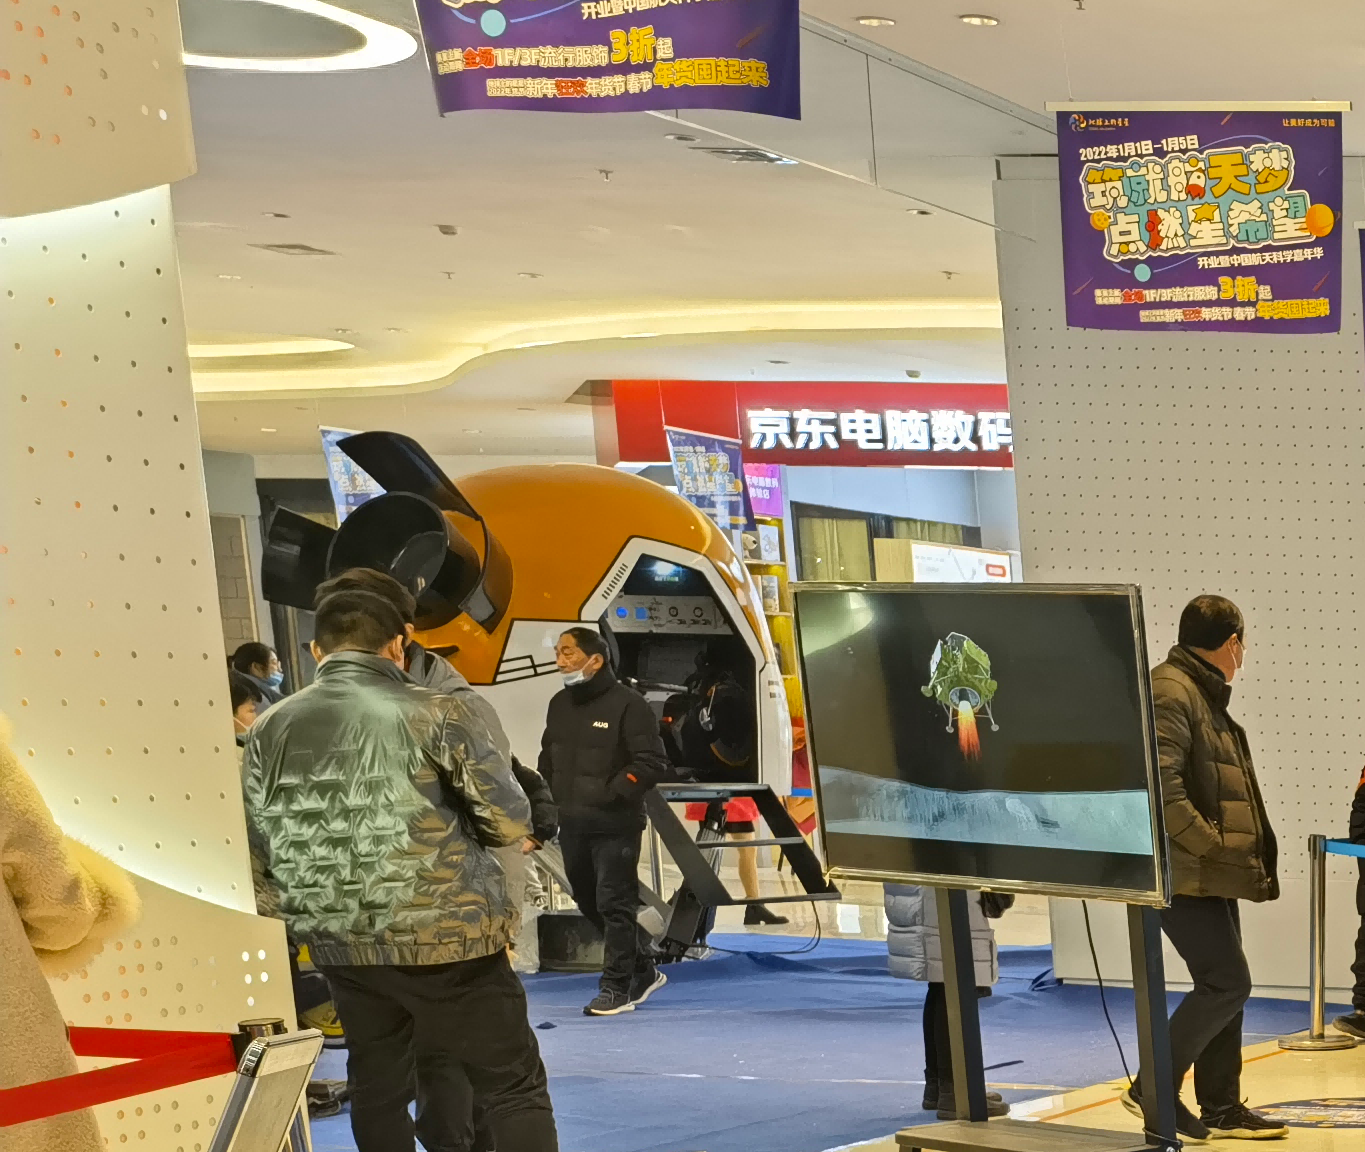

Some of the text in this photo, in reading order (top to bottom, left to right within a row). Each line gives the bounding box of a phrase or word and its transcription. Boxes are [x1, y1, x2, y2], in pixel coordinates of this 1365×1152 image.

[610, 25, 674, 64] 3折起
[653, 57, 770, 88] 年货囤起来
[1079, 135, 1199, 161] 2022年1月1日-1月5日
[1085, 149, 1290, 210] 筑就航天梦
[1108, 196, 1312, 256] 点燃星希望
[1197, 247, 1324, 269] 开业暨中国航天科学嘉年华
[748, 408, 1012, 452] 京东电脑数码
